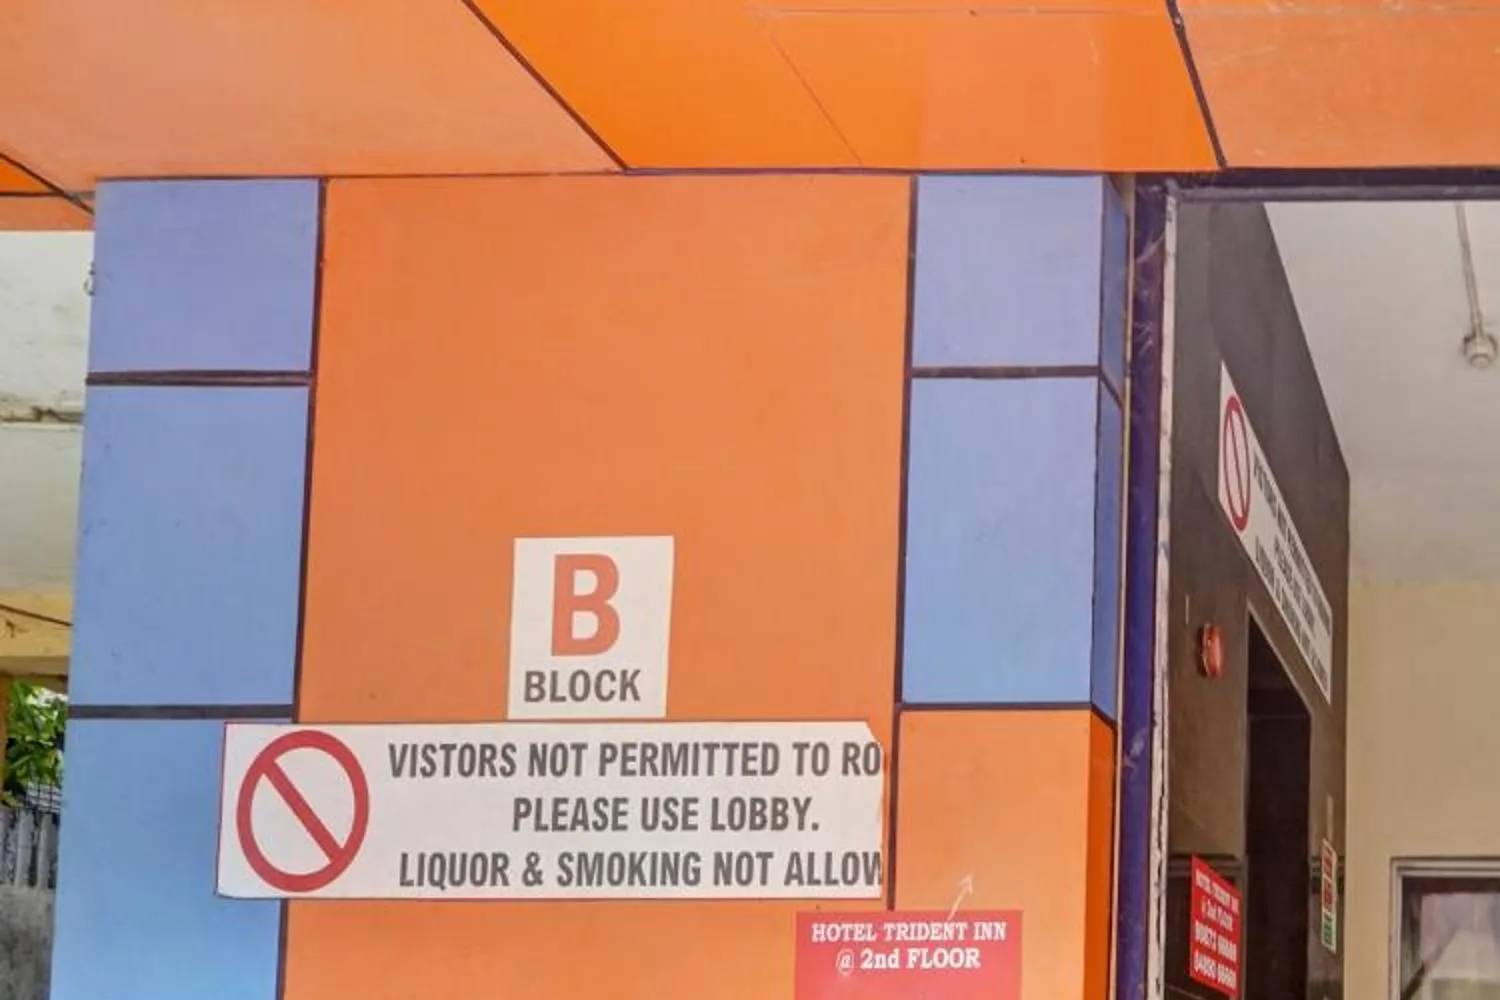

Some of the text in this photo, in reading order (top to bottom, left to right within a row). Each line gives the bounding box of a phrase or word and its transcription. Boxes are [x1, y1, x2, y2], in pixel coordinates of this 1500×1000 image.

[551, 554, 620, 656] B
[525, 670, 640, 702] BLOCK
[389, 743, 516, 777] VISTORS
[528, 743, 588, 777] NOT
[599, 742, 779, 776] PERMITTED
[793, 742, 829, 776] TO
[513, 797, 818, 831] PLEASE USE LOBBY.
[400, 852, 509, 890] LIQUOR
[522, 852, 543, 886] &
[557, 852, 700, 887] SMOKING
[714, 852, 773, 886] NOT
[812, 921, 1007, 942] HOTEL TRIDENT INN
[836, 947, 981, 975] @ 2nd FLOOR
